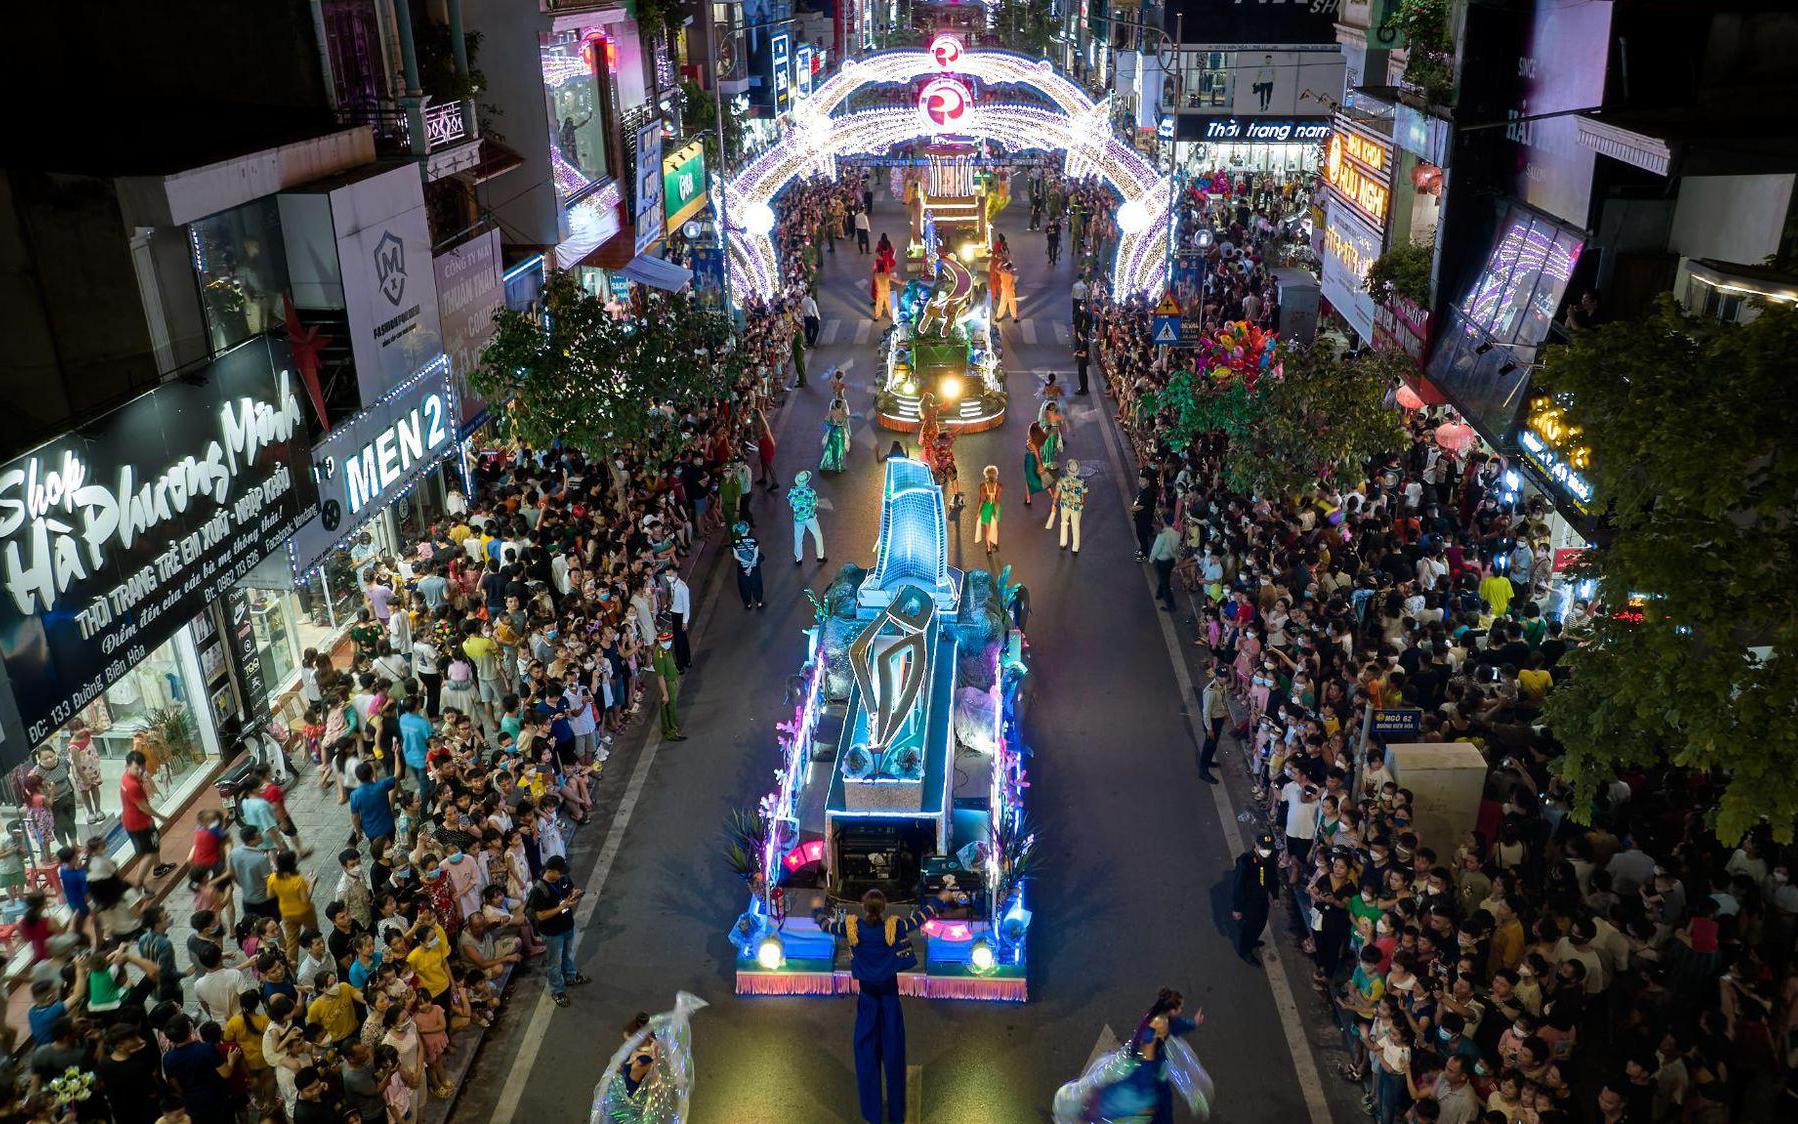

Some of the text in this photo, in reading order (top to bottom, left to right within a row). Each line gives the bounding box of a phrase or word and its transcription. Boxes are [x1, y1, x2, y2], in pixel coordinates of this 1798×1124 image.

[1207, 119, 1329, 141] Thời trang nam
[5, 370, 300, 615] Hà Phương Minh
[346, 408, 423, 514] MEN
[424, 394, 446, 449] 2
[74, 595, 112, 640] THỜI
[108, 565, 158, 616] TRANG
[154, 540, 183, 582] TRẺ
[180, 531, 202, 566] EM
[200, 508, 231, 551] XUẤT
[234, 486, 263, 525] NHẬP
[262, 461, 291, 504] KHẨU
[102, 623, 139, 655] Điểm
[140, 603, 161, 629] đến
[162, 590, 182, 611] của
[184, 572, 202, 594] các
[203, 560, 217, 579] bà
[217, 549, 232, 568] mẹ
[28, 718, 49, 744] ĐC:
[50, 700, 71, 725] 133
[72, 673, 104, 710] Đường
[105, 659, 127, 683] Biên
[127, 644, 146, 666] Hòa
[216, 571, 236, 593] 0962
[235, 561, 247, 579] 113
[245, 549, 260, 571] 626
